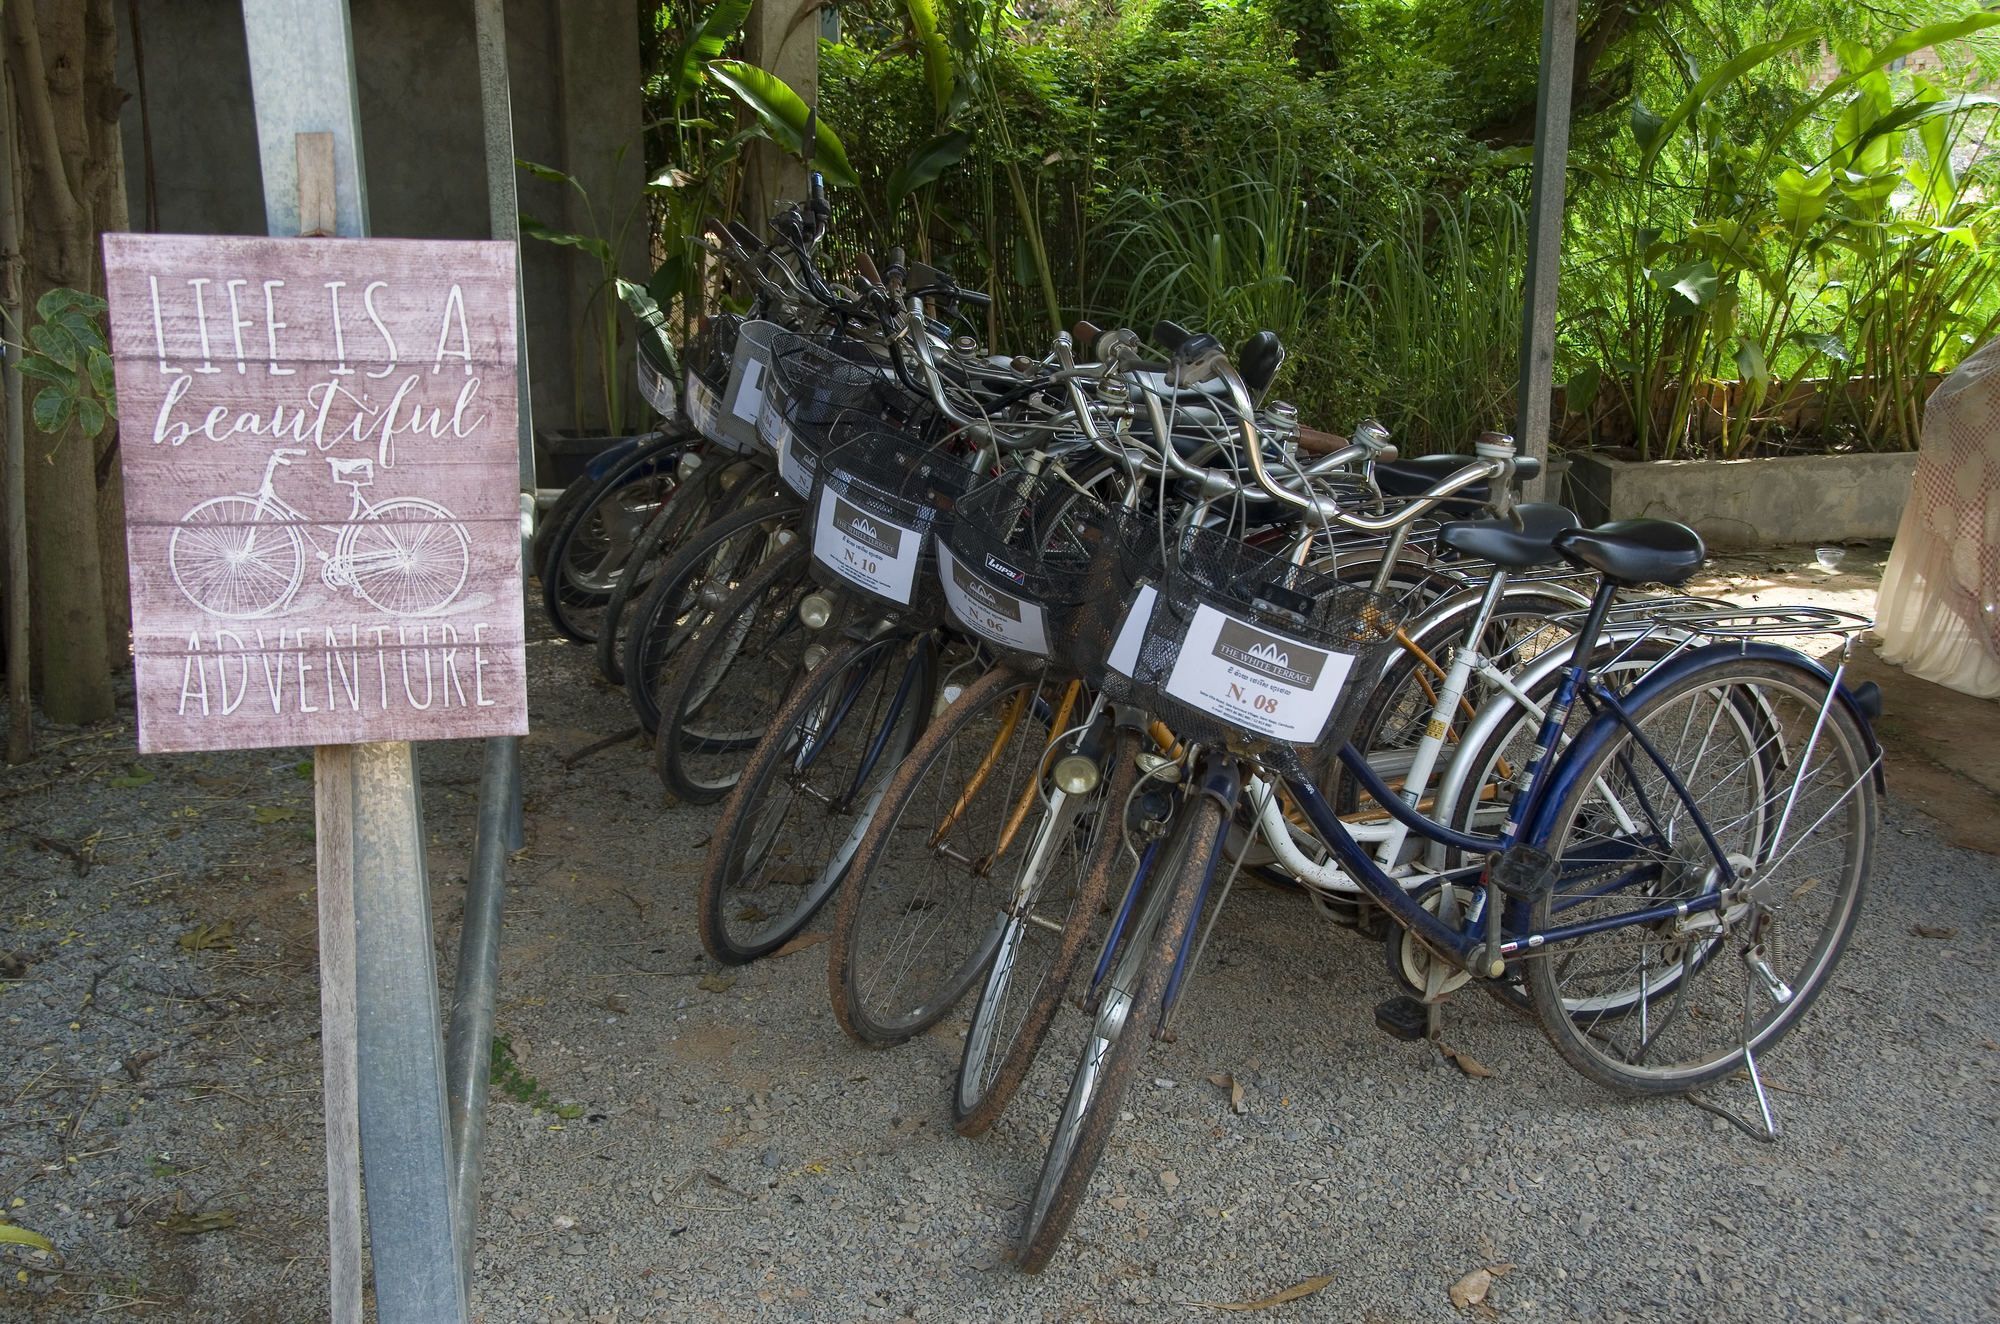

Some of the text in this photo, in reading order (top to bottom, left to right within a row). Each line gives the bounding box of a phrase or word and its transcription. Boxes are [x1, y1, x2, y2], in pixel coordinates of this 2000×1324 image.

[150, 275, 474, 378] LIFE IS A
[153, 374, 487, 468] beautiful
[844, 548, 857, 565] N.
[861, 559, 876, 574] 10
[987, 618, 1003, 633] 06
[178, 622, 495, 716] ADVENTURE
[1220, 644, 1239, 658] THE
[1240, 652, 1272, 671] WHITE
[1271, 663, 1313, 684] TERRACE
[1225, 682, 1247, 704] N.
[1253, 694, 1278, 714] 08
